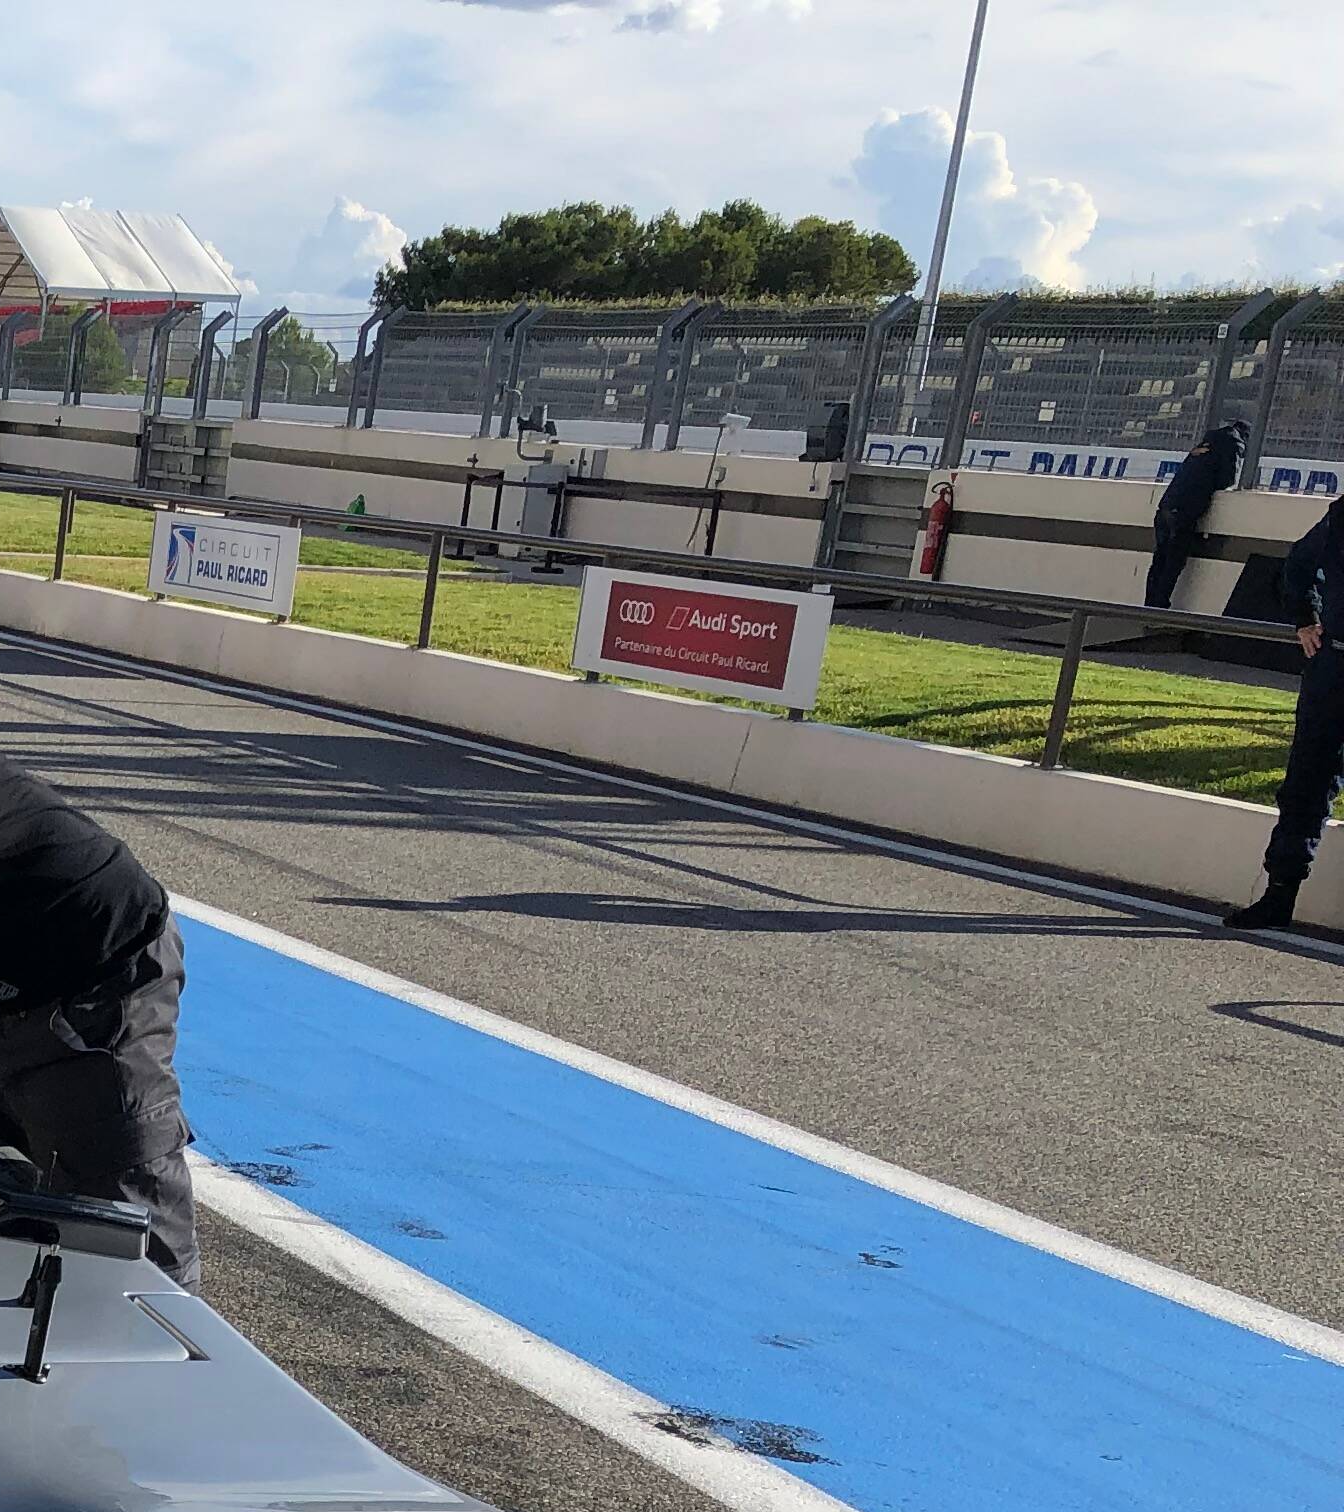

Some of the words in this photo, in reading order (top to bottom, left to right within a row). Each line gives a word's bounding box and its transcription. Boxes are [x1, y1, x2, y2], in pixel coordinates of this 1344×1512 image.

[199, 538, 272, 561] CIRCUIT
[196, 559, 223, 580] PAUL
[226, 564, 268, 587] RICARD
[688, 610, 728, 631] Audi
[729, 615, 779, 640] Sport
[614, 636, 663, 656] Partenaire
[663, 645, 677, 658] du
[678, 647, 710, 664] Circuit
[711, 652, 734, 669] Paul
